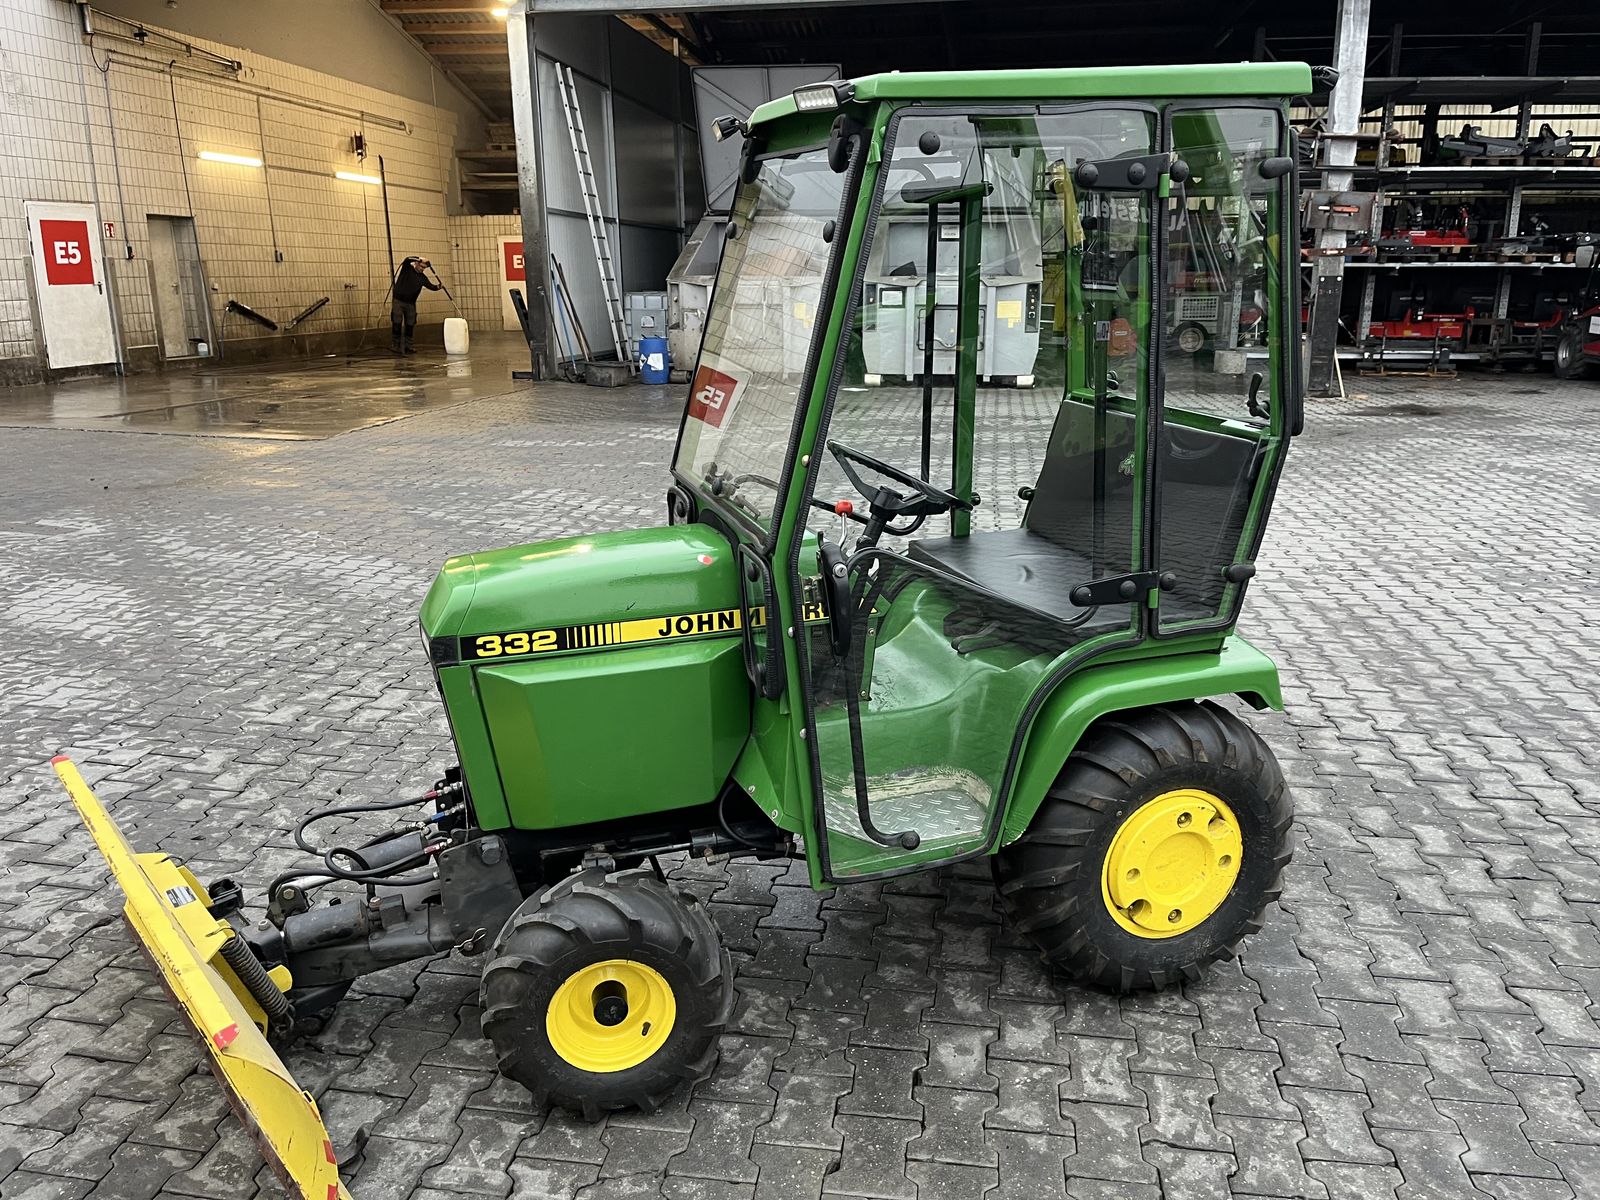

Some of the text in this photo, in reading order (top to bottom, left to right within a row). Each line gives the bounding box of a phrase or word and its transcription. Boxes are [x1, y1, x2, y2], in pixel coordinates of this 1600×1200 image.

[53, 241, 82, 265] E5
[512, 254, 525, 269] E
[476, 630, 558, 657] 332
[658, 610, 735, 637] JOHN
